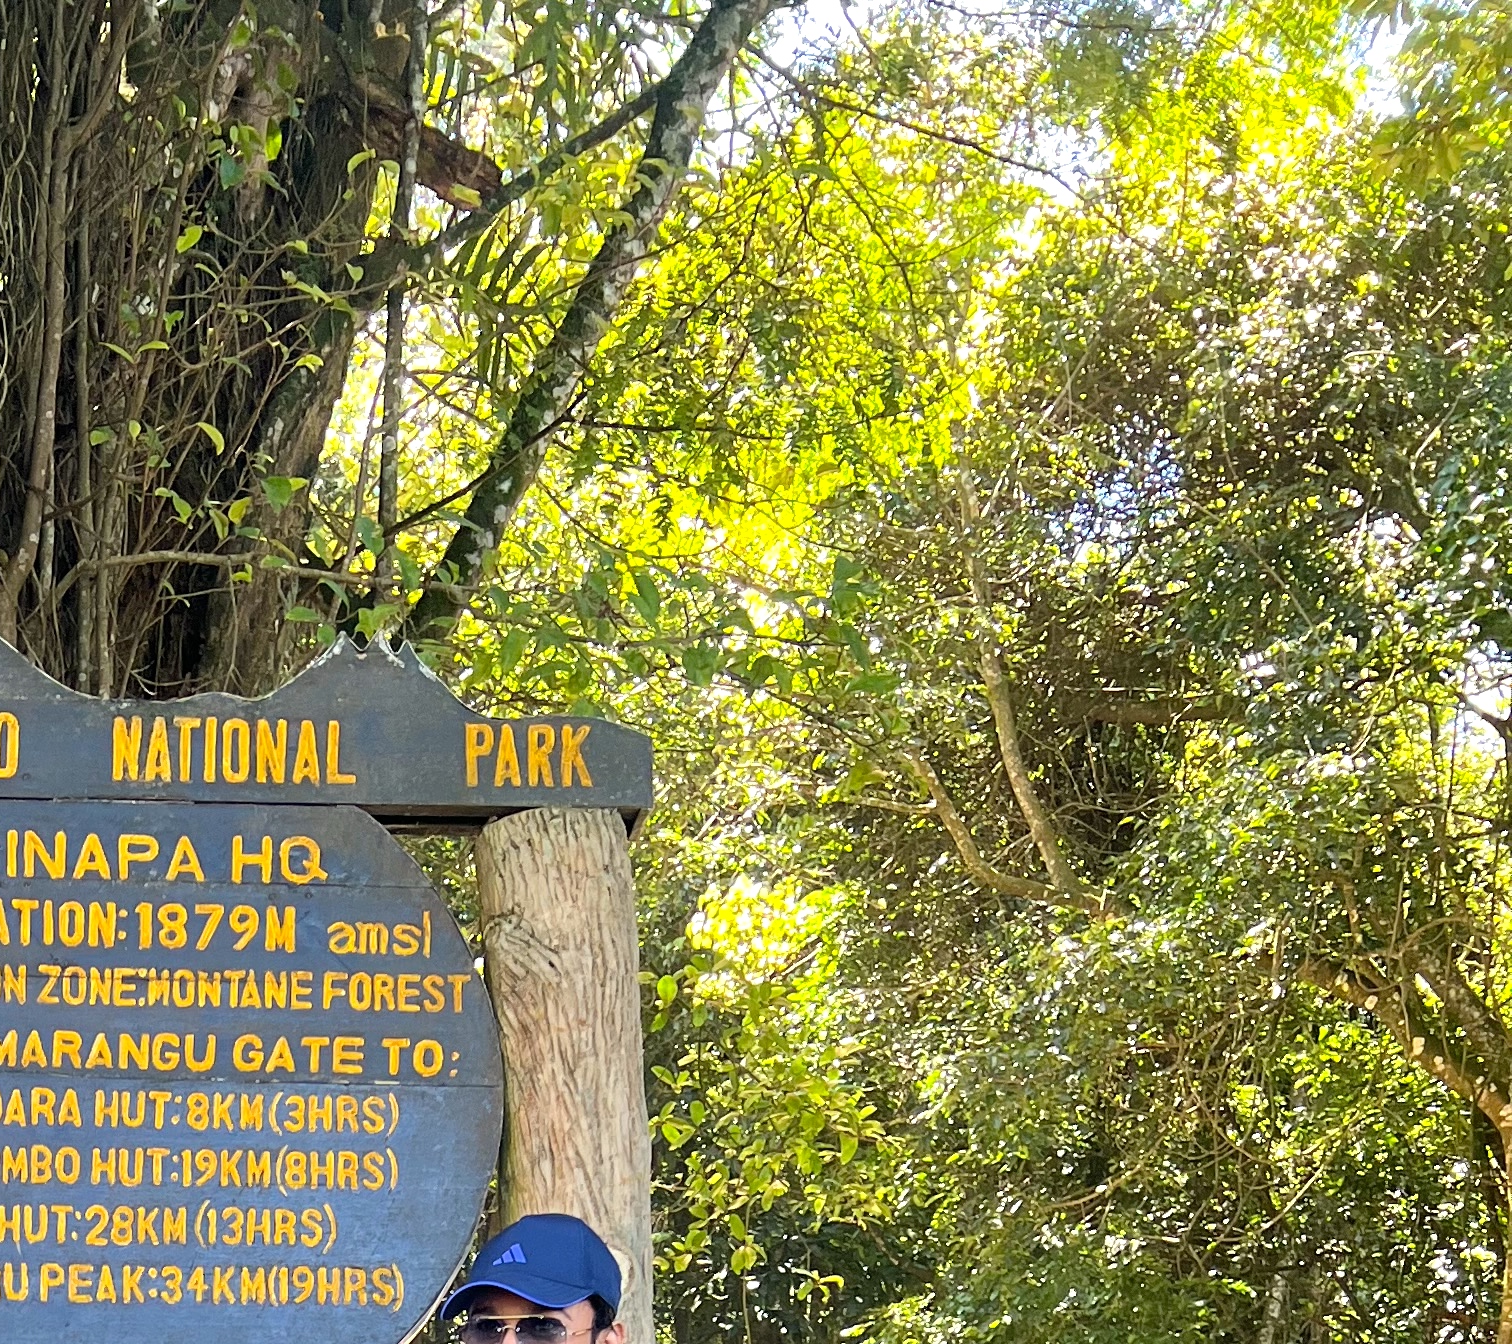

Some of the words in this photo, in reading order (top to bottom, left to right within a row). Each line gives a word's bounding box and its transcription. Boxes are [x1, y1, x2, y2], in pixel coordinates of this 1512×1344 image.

[111, 716, 357, 785] NATIONAL
[463, 720, 595, 789] PARK
[231, 836, 328, 886] HQ
[328, 912, 432, 957] amsl
[321, 970, 473, 1014] FOREST
[232, 1033, 364, 1075] GATE
[381, 1036, 461, 1079] TO:
